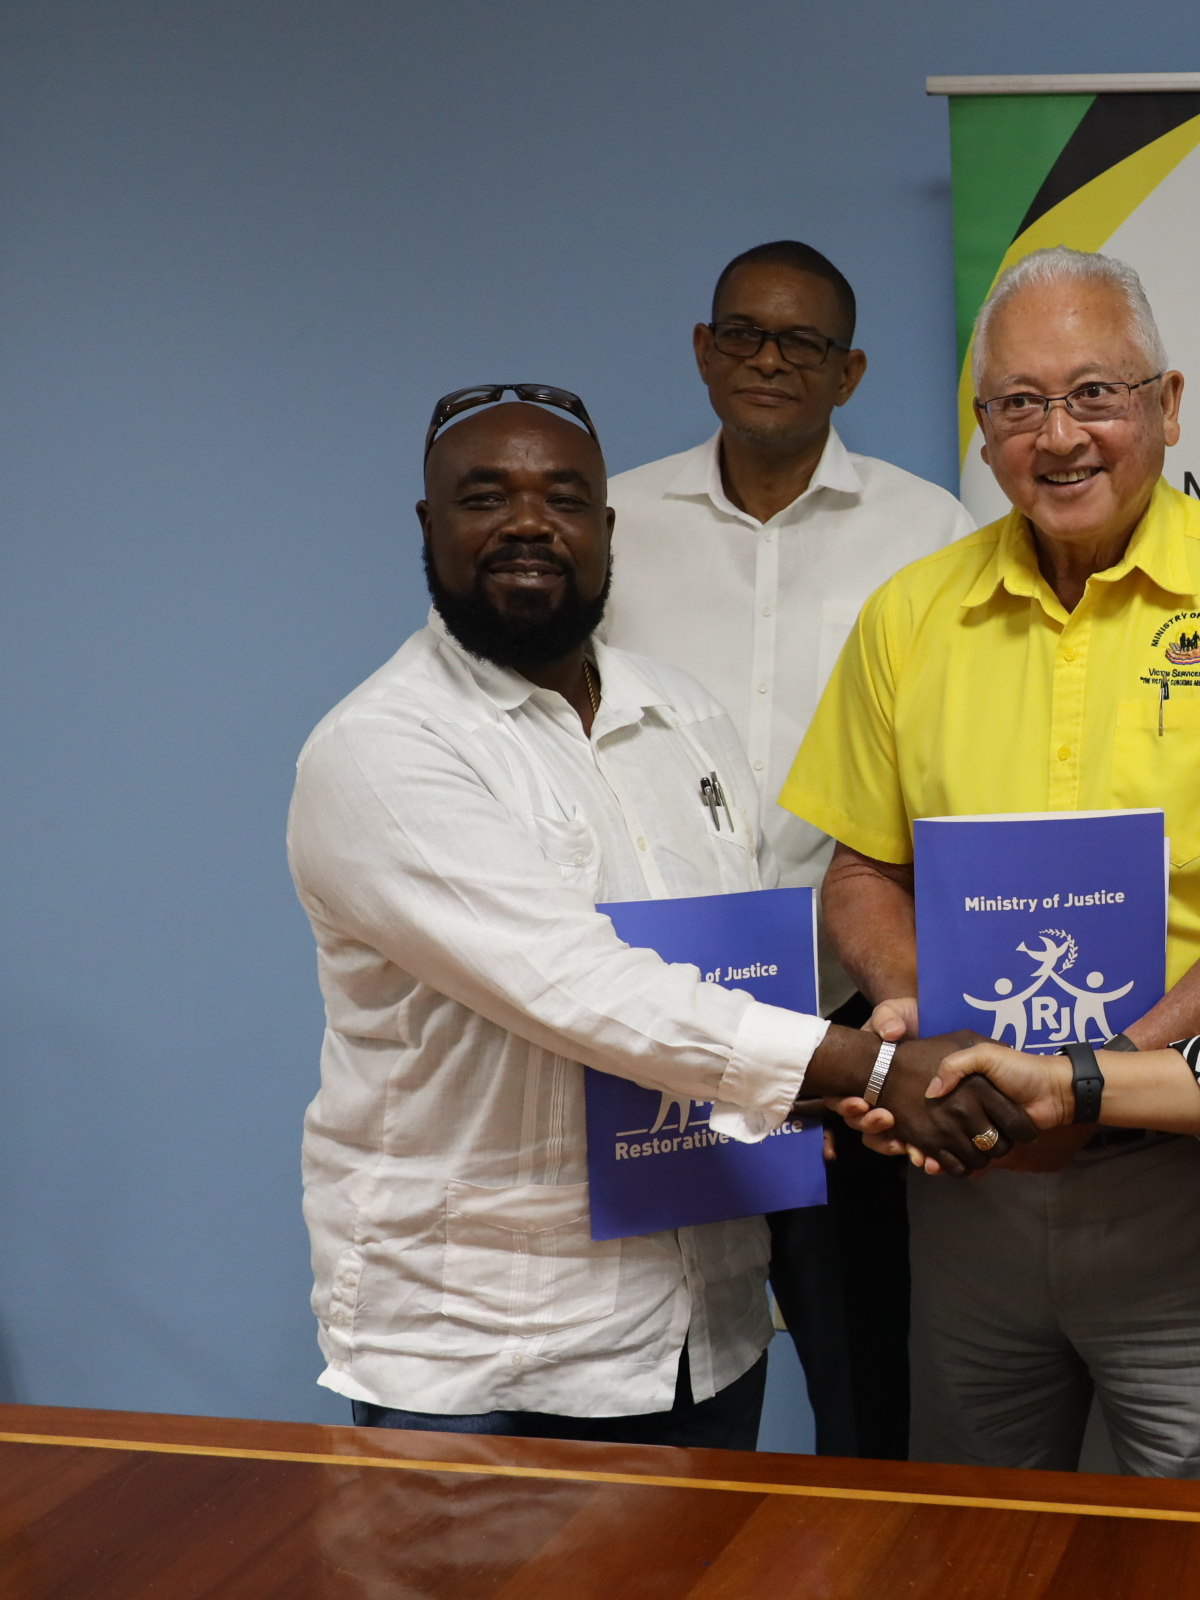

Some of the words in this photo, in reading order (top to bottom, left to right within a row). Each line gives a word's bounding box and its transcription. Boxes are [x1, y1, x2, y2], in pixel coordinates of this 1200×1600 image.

[1151, 612, 1187, 647] MINISTRY
[965, 895, 1038, 913] Ministry
[1042, 893, 1060, 909] of
[1063, 889, 1125, 908] Justice
[705, 967, 721, 983] of
[723, 962, 778, 982] Justice
[1032, 996, 1071, 1042] RJ
[615, 1128, 730, 1161] Restorative
